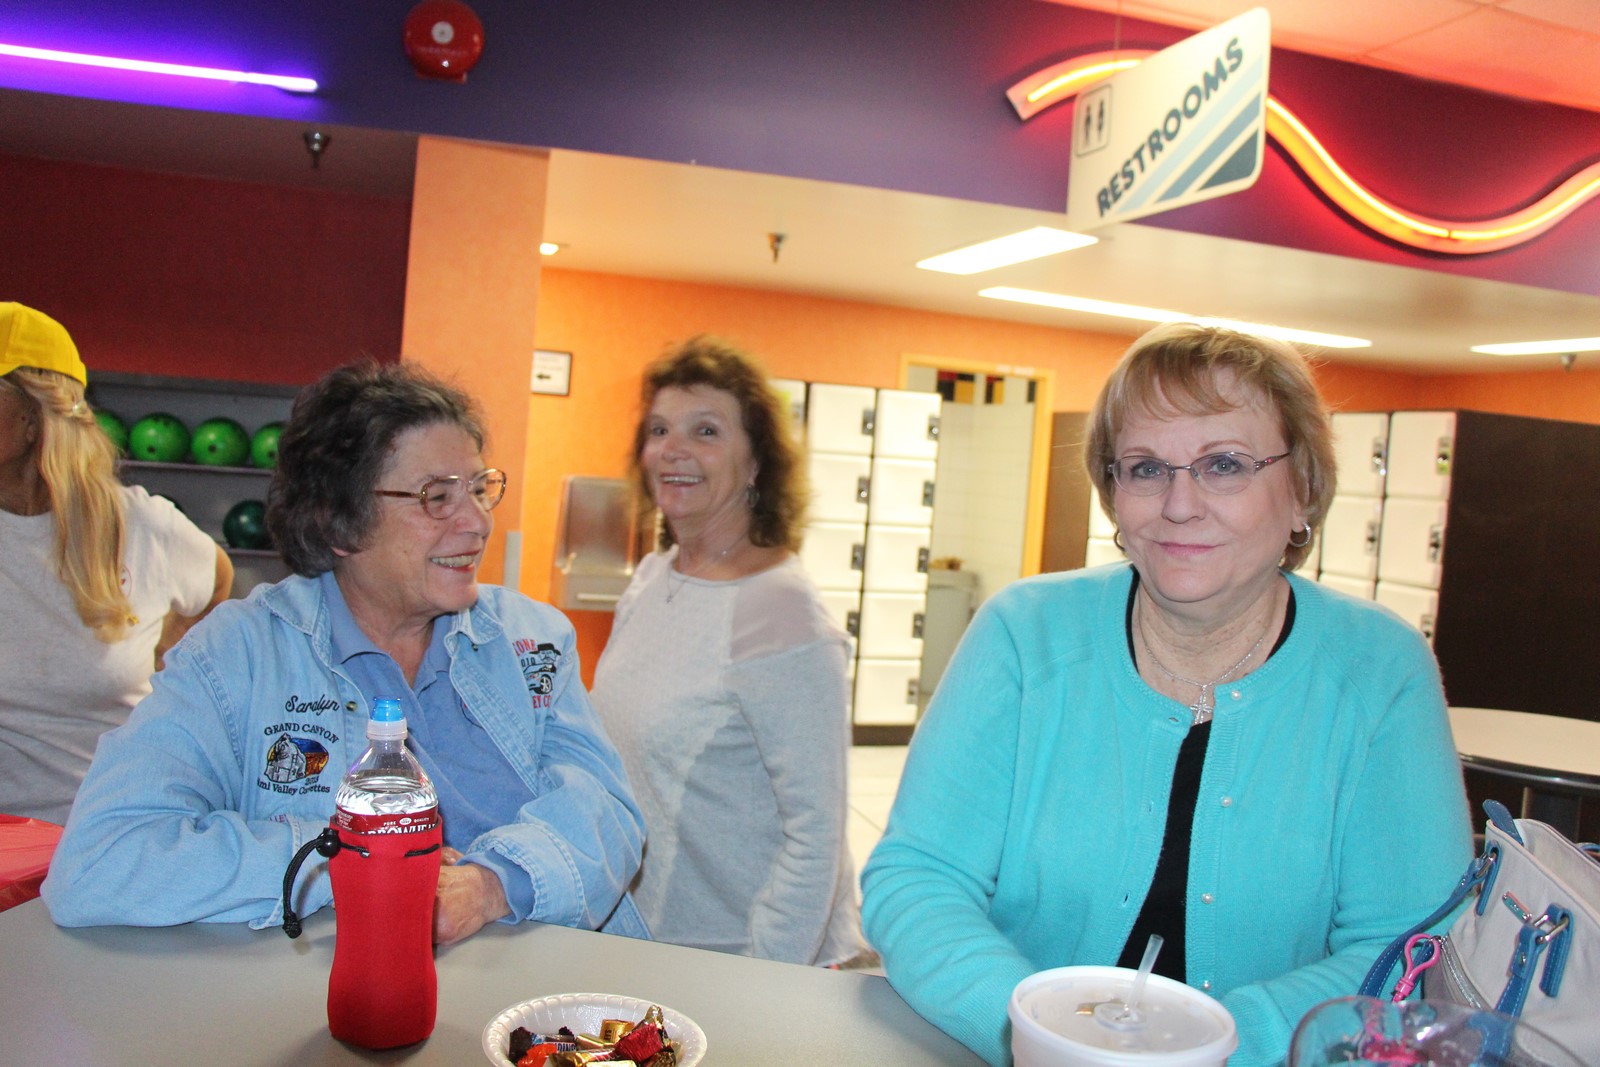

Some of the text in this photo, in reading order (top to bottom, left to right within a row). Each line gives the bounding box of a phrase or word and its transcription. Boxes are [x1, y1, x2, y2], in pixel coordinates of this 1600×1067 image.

[1096, 37, 1243, 218] RESTROOMS
[264, 723, 300, 736] GRAND
[272, 783, 298, 796] Valley
